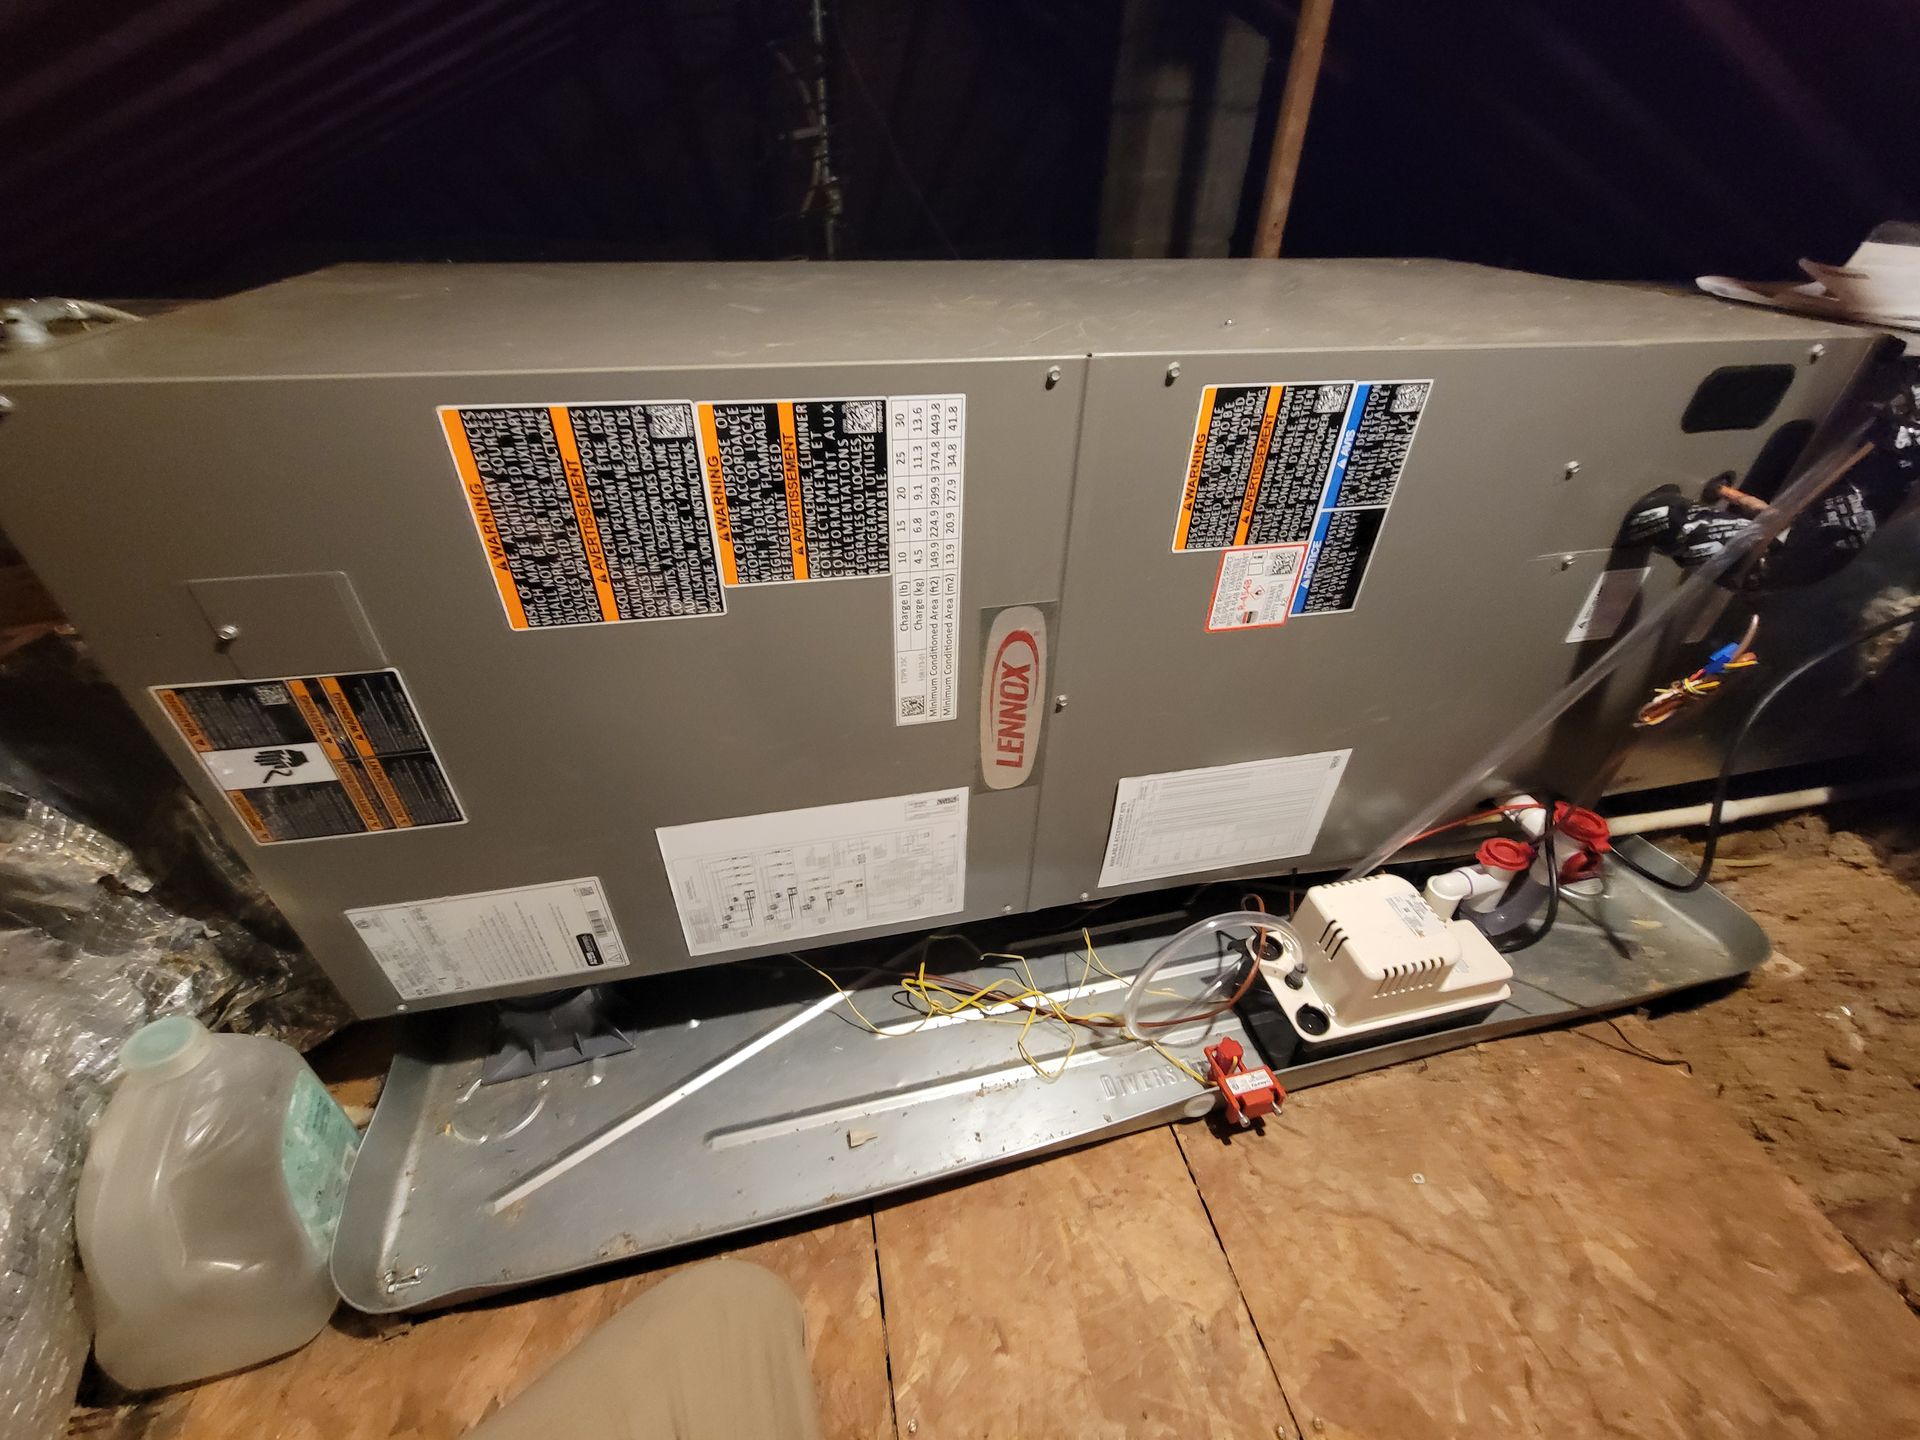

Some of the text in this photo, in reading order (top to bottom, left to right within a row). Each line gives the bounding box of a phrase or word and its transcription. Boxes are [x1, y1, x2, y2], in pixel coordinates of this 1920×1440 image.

[586, 409, 603, 433] DES
[615, 409, 631, 424] DE
[712, 408, 728, 429] OF
[821, 403, 835, 440] AUX
[1222, 400, 1235, 418] BE
[1242, 390, 1257, 415] NOT
[459, 410, 492, 471] DEVICES
[504, 409, 537, 476] AUXILIARY
[569, 409, 600, 485] DISPOSITIFS
[600, 409, 624, 460] DOIVENT
[751, 405, 773, 488] FLAMMABLE
[792, 403, 811, 469] ÉLIMINER
[1200, 406, 1225, 477] FLAMMABLE
[1218, 421, 1231, 435] TO
[1238, 417, 1251, 435] DO
[1339, 429, 1356, 456] AVIS
[612, 463, 628, 478] NE
[629, 475, 644, 487] LE
[717, 438, 737, 496] DISPOSE
[1184, 432, 1206, 499] WARNING
[1203, 396, 1246, 547] REPAIRED ONLY BY TRAINED
[1242, 412, 1275, 512] AVERTISSEMENT
[525, 479, 547, 514] THAN
[589, 489, 606, 509] LES
[602, 478, 625, 530] PEUVENT
[632, 490, 650, 520] DANS
[706, 455, 728, 529] WARNING
[725, 406, 761, 582] PROPERLY IN ACCORDANCE
[738, 406, 773, 581] WITH FEDERAL OR LOCAL
[781, 432, 803, 543] AVERTISSEMENT
[809, 430, 832, 577] CORRECTEMENT ET
[852, 493, 864, 511] OU
[468, 482, 504, 557] WARNING
[475, 411, 553, 625] WHICH MAY BE IGNITION SOURCES
[481, 476, 515, 544] AUXILIARY
[490, 410, 566, 624] SHALL NOT BE INSTALLED IN THE
[519, 409, 590, 622] DEVICES LISTED FOR USE WITH THE
[559, 500, 575, 519] SEE
[565, 458, 604, 570] AVERTISSEMENT
[894, 413, 910, 631] Charge (lb) 10 15 20 25 30
[912, 406, 924, 631] Charge (kg) 4.5 6.8 9.1 11.3 13.6
[1190, 511, 1202, 525] OF
[1194, 476, 1219, 548] REFRIGERANT
[1213, 507, 1230, 547] SERVICE
[536, 518, 559, 554] OTHER
[615, 533, 631, 554] QUI
[732, 536, 746, 554] OF
[774, 491, 794, 580] REFRIGERANT
[1185, 525, 1199, 548] RISK
[735, 557, 750, 582] RISK
[807, 540, 821, 578] RISQUE
[928, 402, 940, 717] Minimum Conditioned Area (ft2) 149.9 224.9 299.9 374.8 449.8
[942, 405, 957, 716] Minimum Conditioned Area (m2) 13.9 20.9 27.9 34.8 41.8
[1302, 540, 1322, 578] NOTICE
[516, 583, 532, 599] OF
[580, 579, 602, 621] SPECIFIC
[612, 581, 632, 618] RISQUE
[621, 557, 645, 618] AUXILIAIRES
[637, 575, 657, 617] SOURCES
[656, 599, 670, 616] PAS
[523, 603, 541, 626] RISK
[296, 694, 329, 735] WARNING
[330, 692, 360, 732] WARNING
[996, 660, 1031, 768] LENNOX
